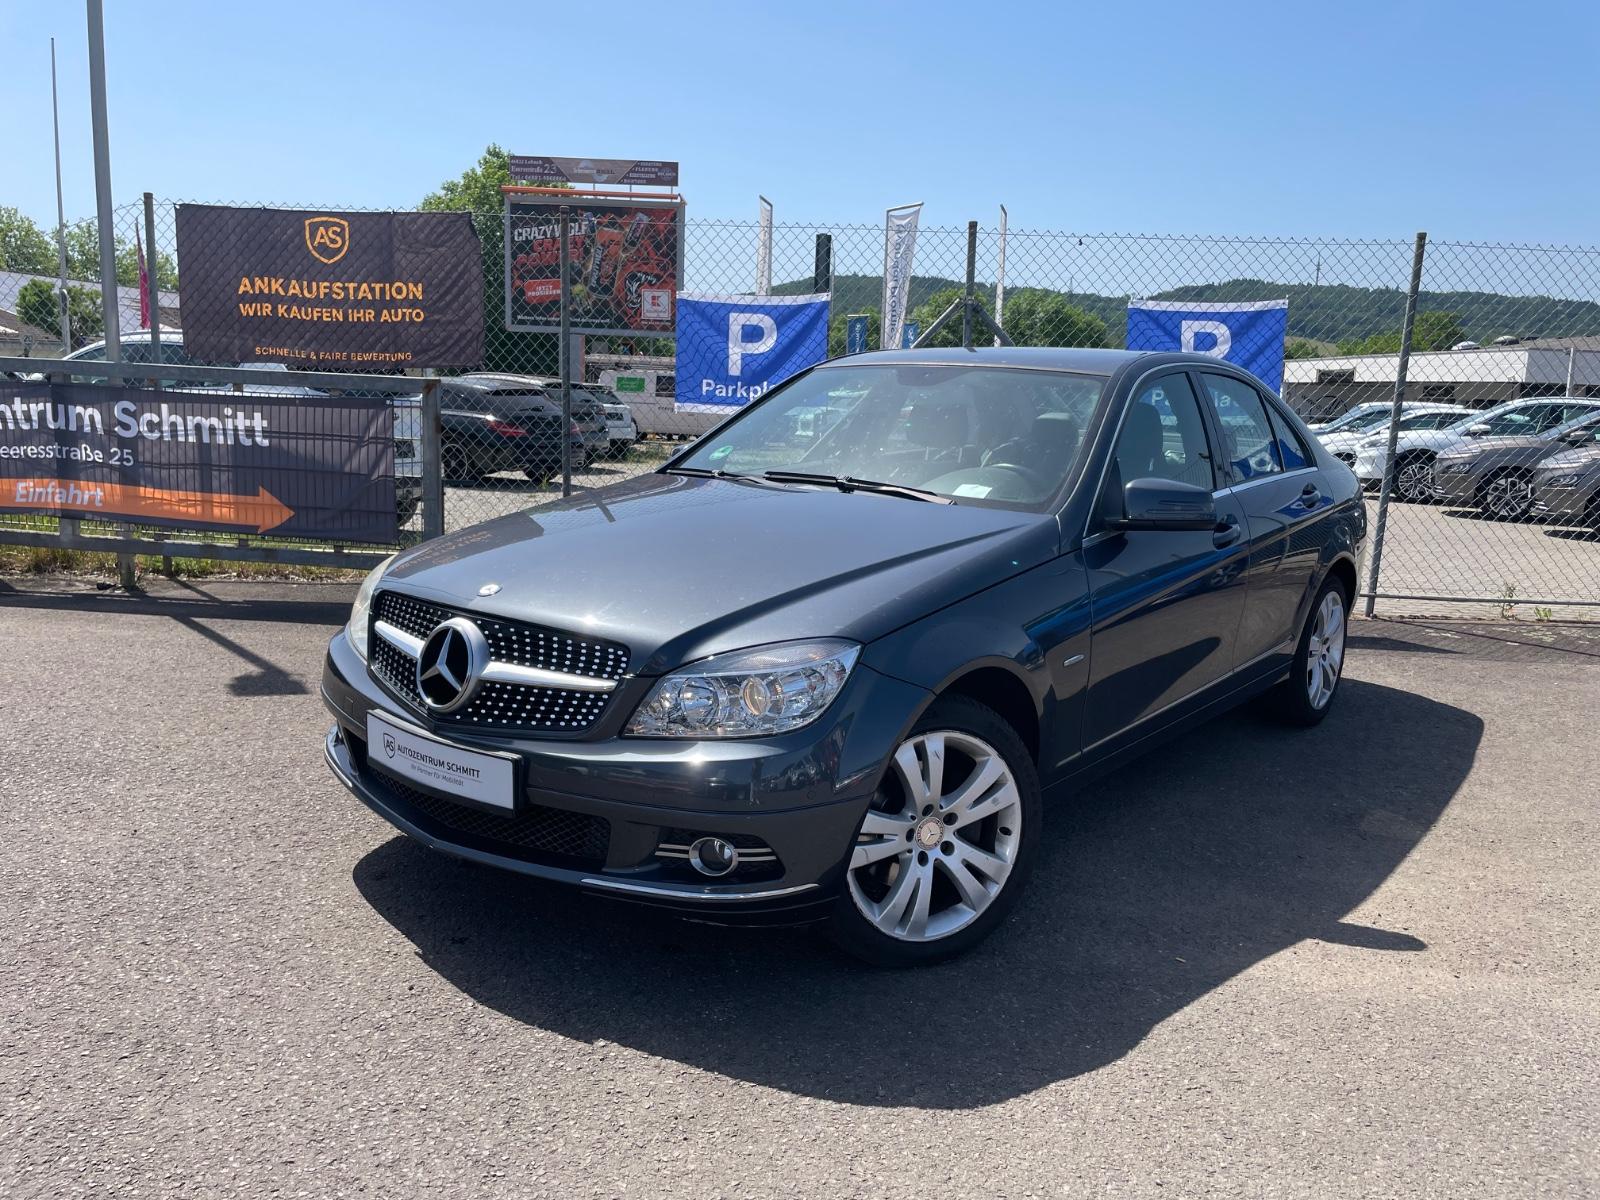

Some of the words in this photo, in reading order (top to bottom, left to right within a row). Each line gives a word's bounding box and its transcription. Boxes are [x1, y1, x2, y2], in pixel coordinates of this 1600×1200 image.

[313, 225, 342, 250] AS
[238, 276, 424, 300] ANKAUFSTATION
[238, 303, 273, 318] WIR
[277, 303, 344, 322] KAUFEN
[348, 308, 375, 322] IHR
[380, 308, 426, 323] AUTO
[728, 312, 778, 377] P
[1181, 320, 1232, 358] P
[255, 346, 307, 359] SCHNELLE
[309, 351, 317, 360] &
[319, 351, 348, 361] FAIRE
[350, 351, 412, 362] BEWERTUNG
[702, 379, 777, 402] Parkpl
[114, 400, 270, 447] Schmitt
[108, 447, 135, 467] 25
[15, 480, 105, 507] Einfahrt
[386, 738, 395, 751] AS
[397, 743, 446, 769] AUTOZENTRUM
[446, 760, 481, 779] SCHMITT
